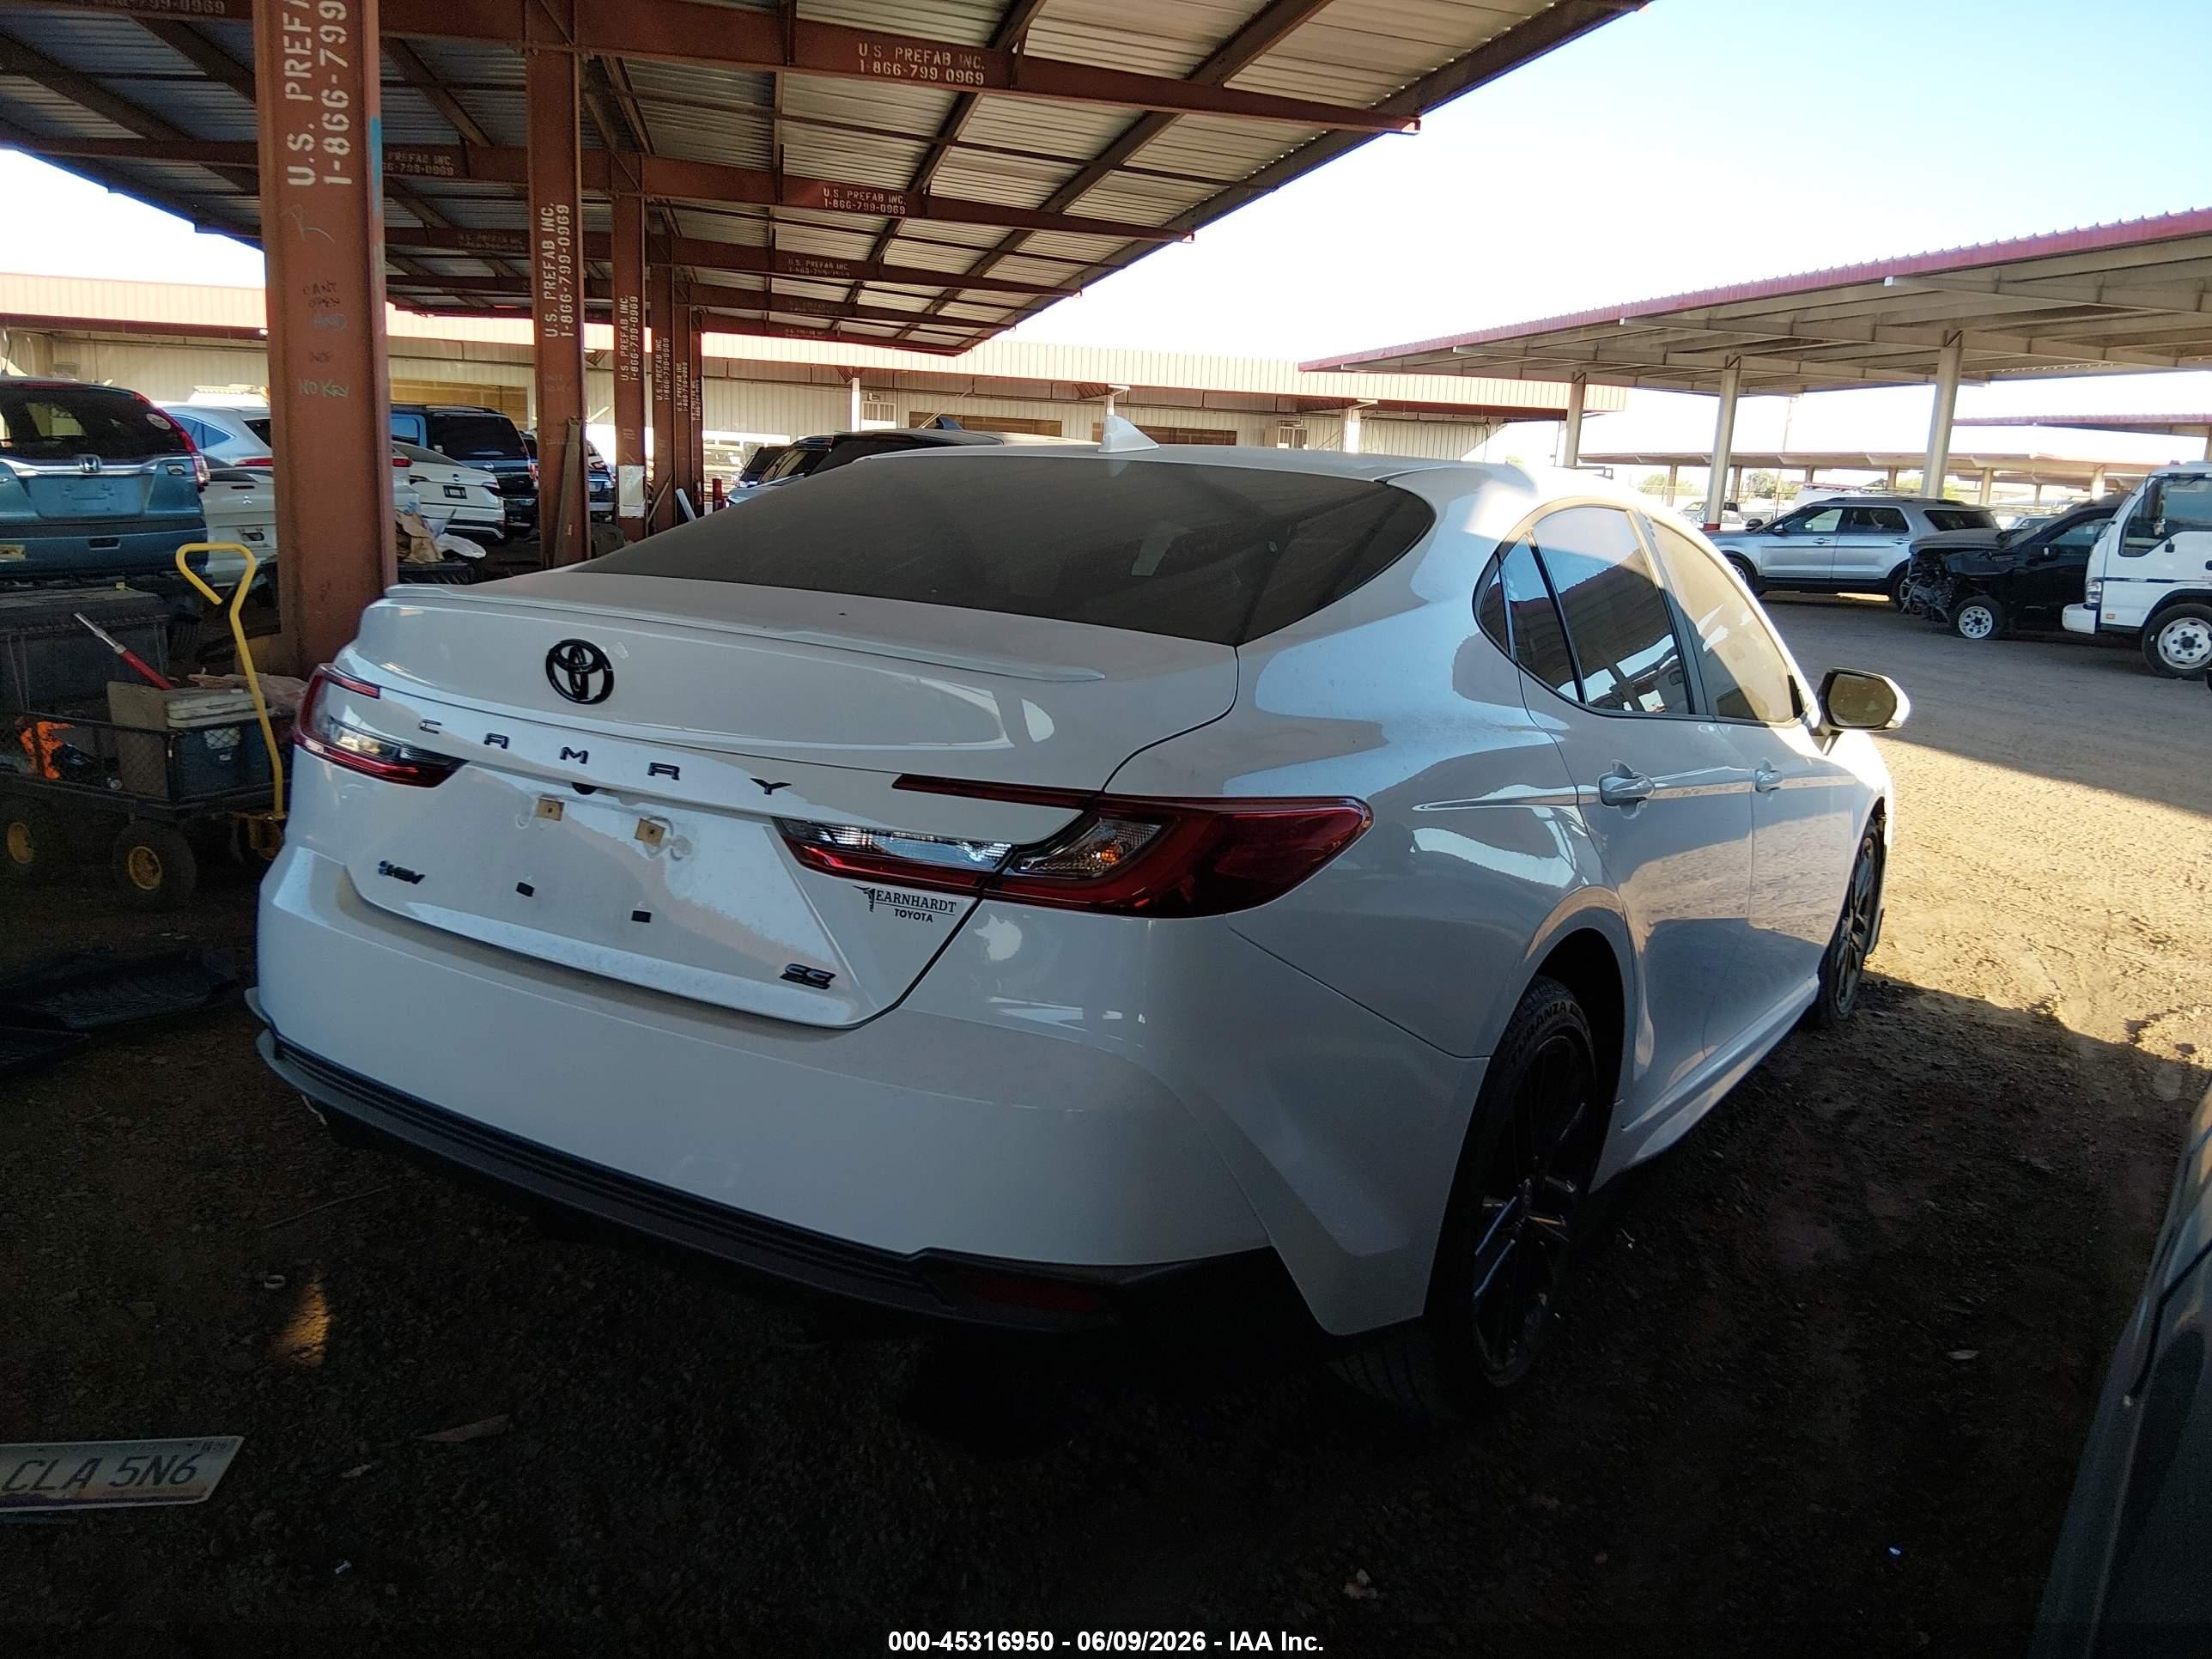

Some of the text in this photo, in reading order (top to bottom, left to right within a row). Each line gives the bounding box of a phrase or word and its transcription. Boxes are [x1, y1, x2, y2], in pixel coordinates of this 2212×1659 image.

[895, 46, 951, 66] PREFAB
[287, 124, 316, 185] U.S.
[541, 202, 556, 233] INC.
[847, 190, 884, 203] PREFAB
[888, 194, 907, 206] INC.
[542, 240, 557, 301] PREFAB
[556, 204, 574, 337] 1-866-799-0969
[619, 318, 629, 358] PREFAB
[419, 718, 792, 796] CAMRY
[876, 889, 957, 913] EARNHARDT
[894, 908, 933, 923] TOYOTA
[2, 1453, 203, 1492] CLA 5N6
